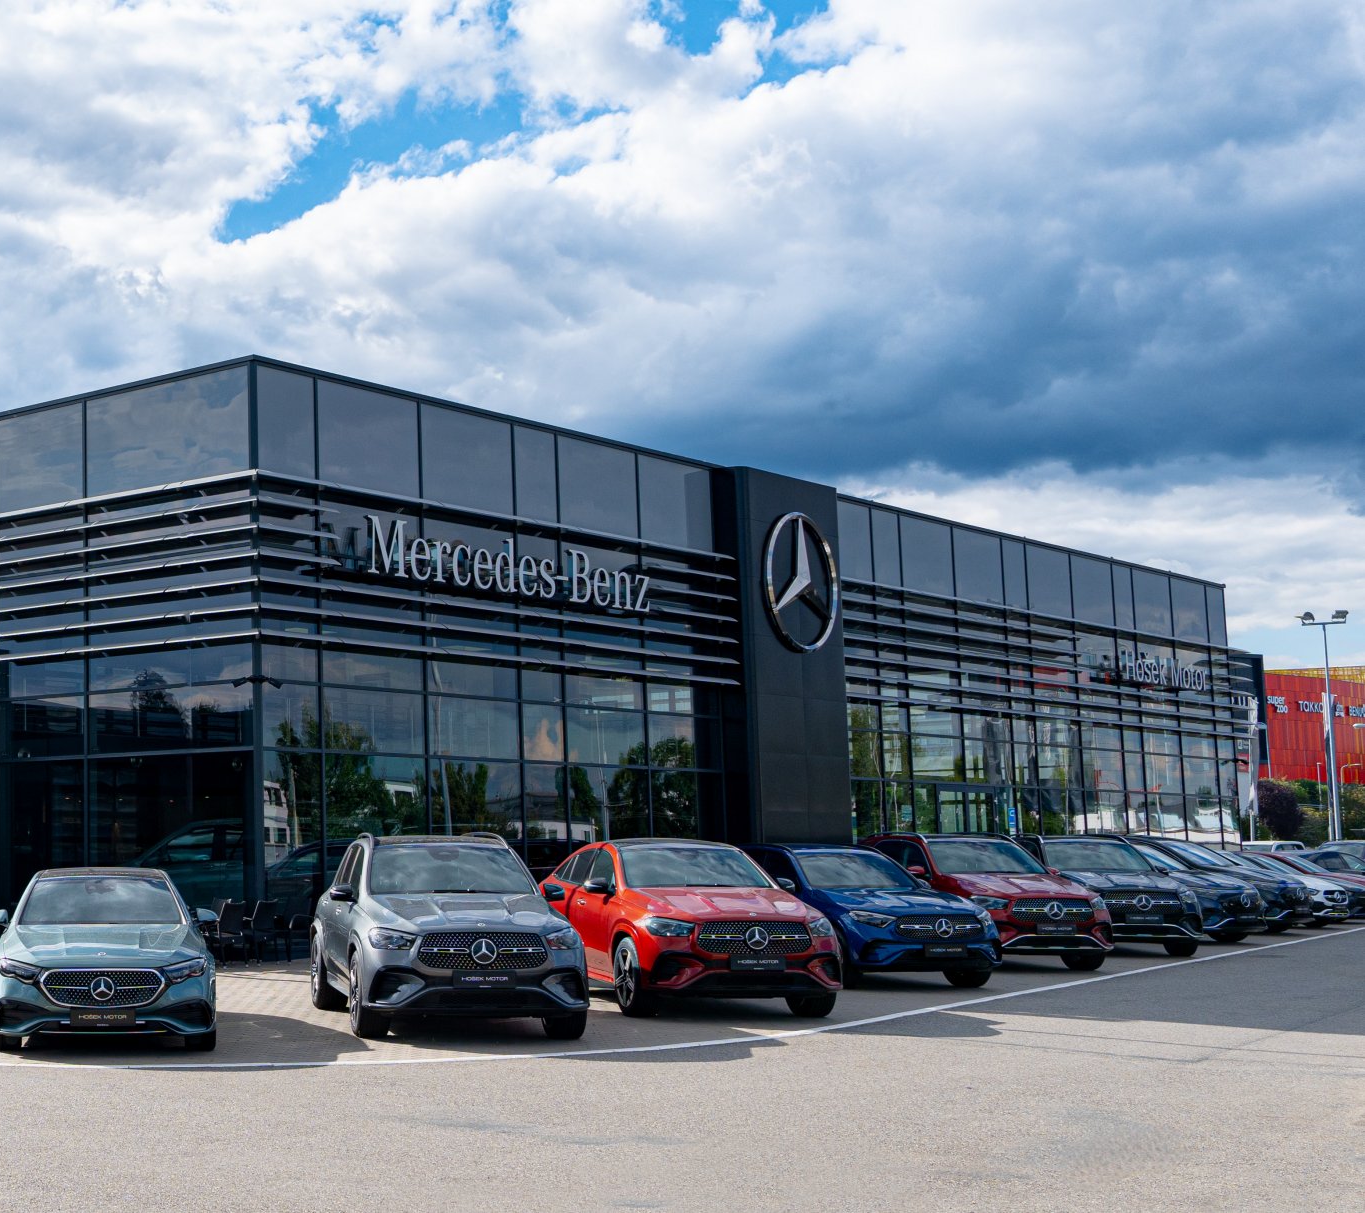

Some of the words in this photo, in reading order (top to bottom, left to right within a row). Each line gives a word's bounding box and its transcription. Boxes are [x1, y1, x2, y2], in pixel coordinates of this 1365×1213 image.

[365, 514, 650, 613] Mercedes-Benz
[1125, 649, 1167, 686] Hošek
[1171, 658, 1206, 691] Motor
[1266, 695, 1285, 705] super
